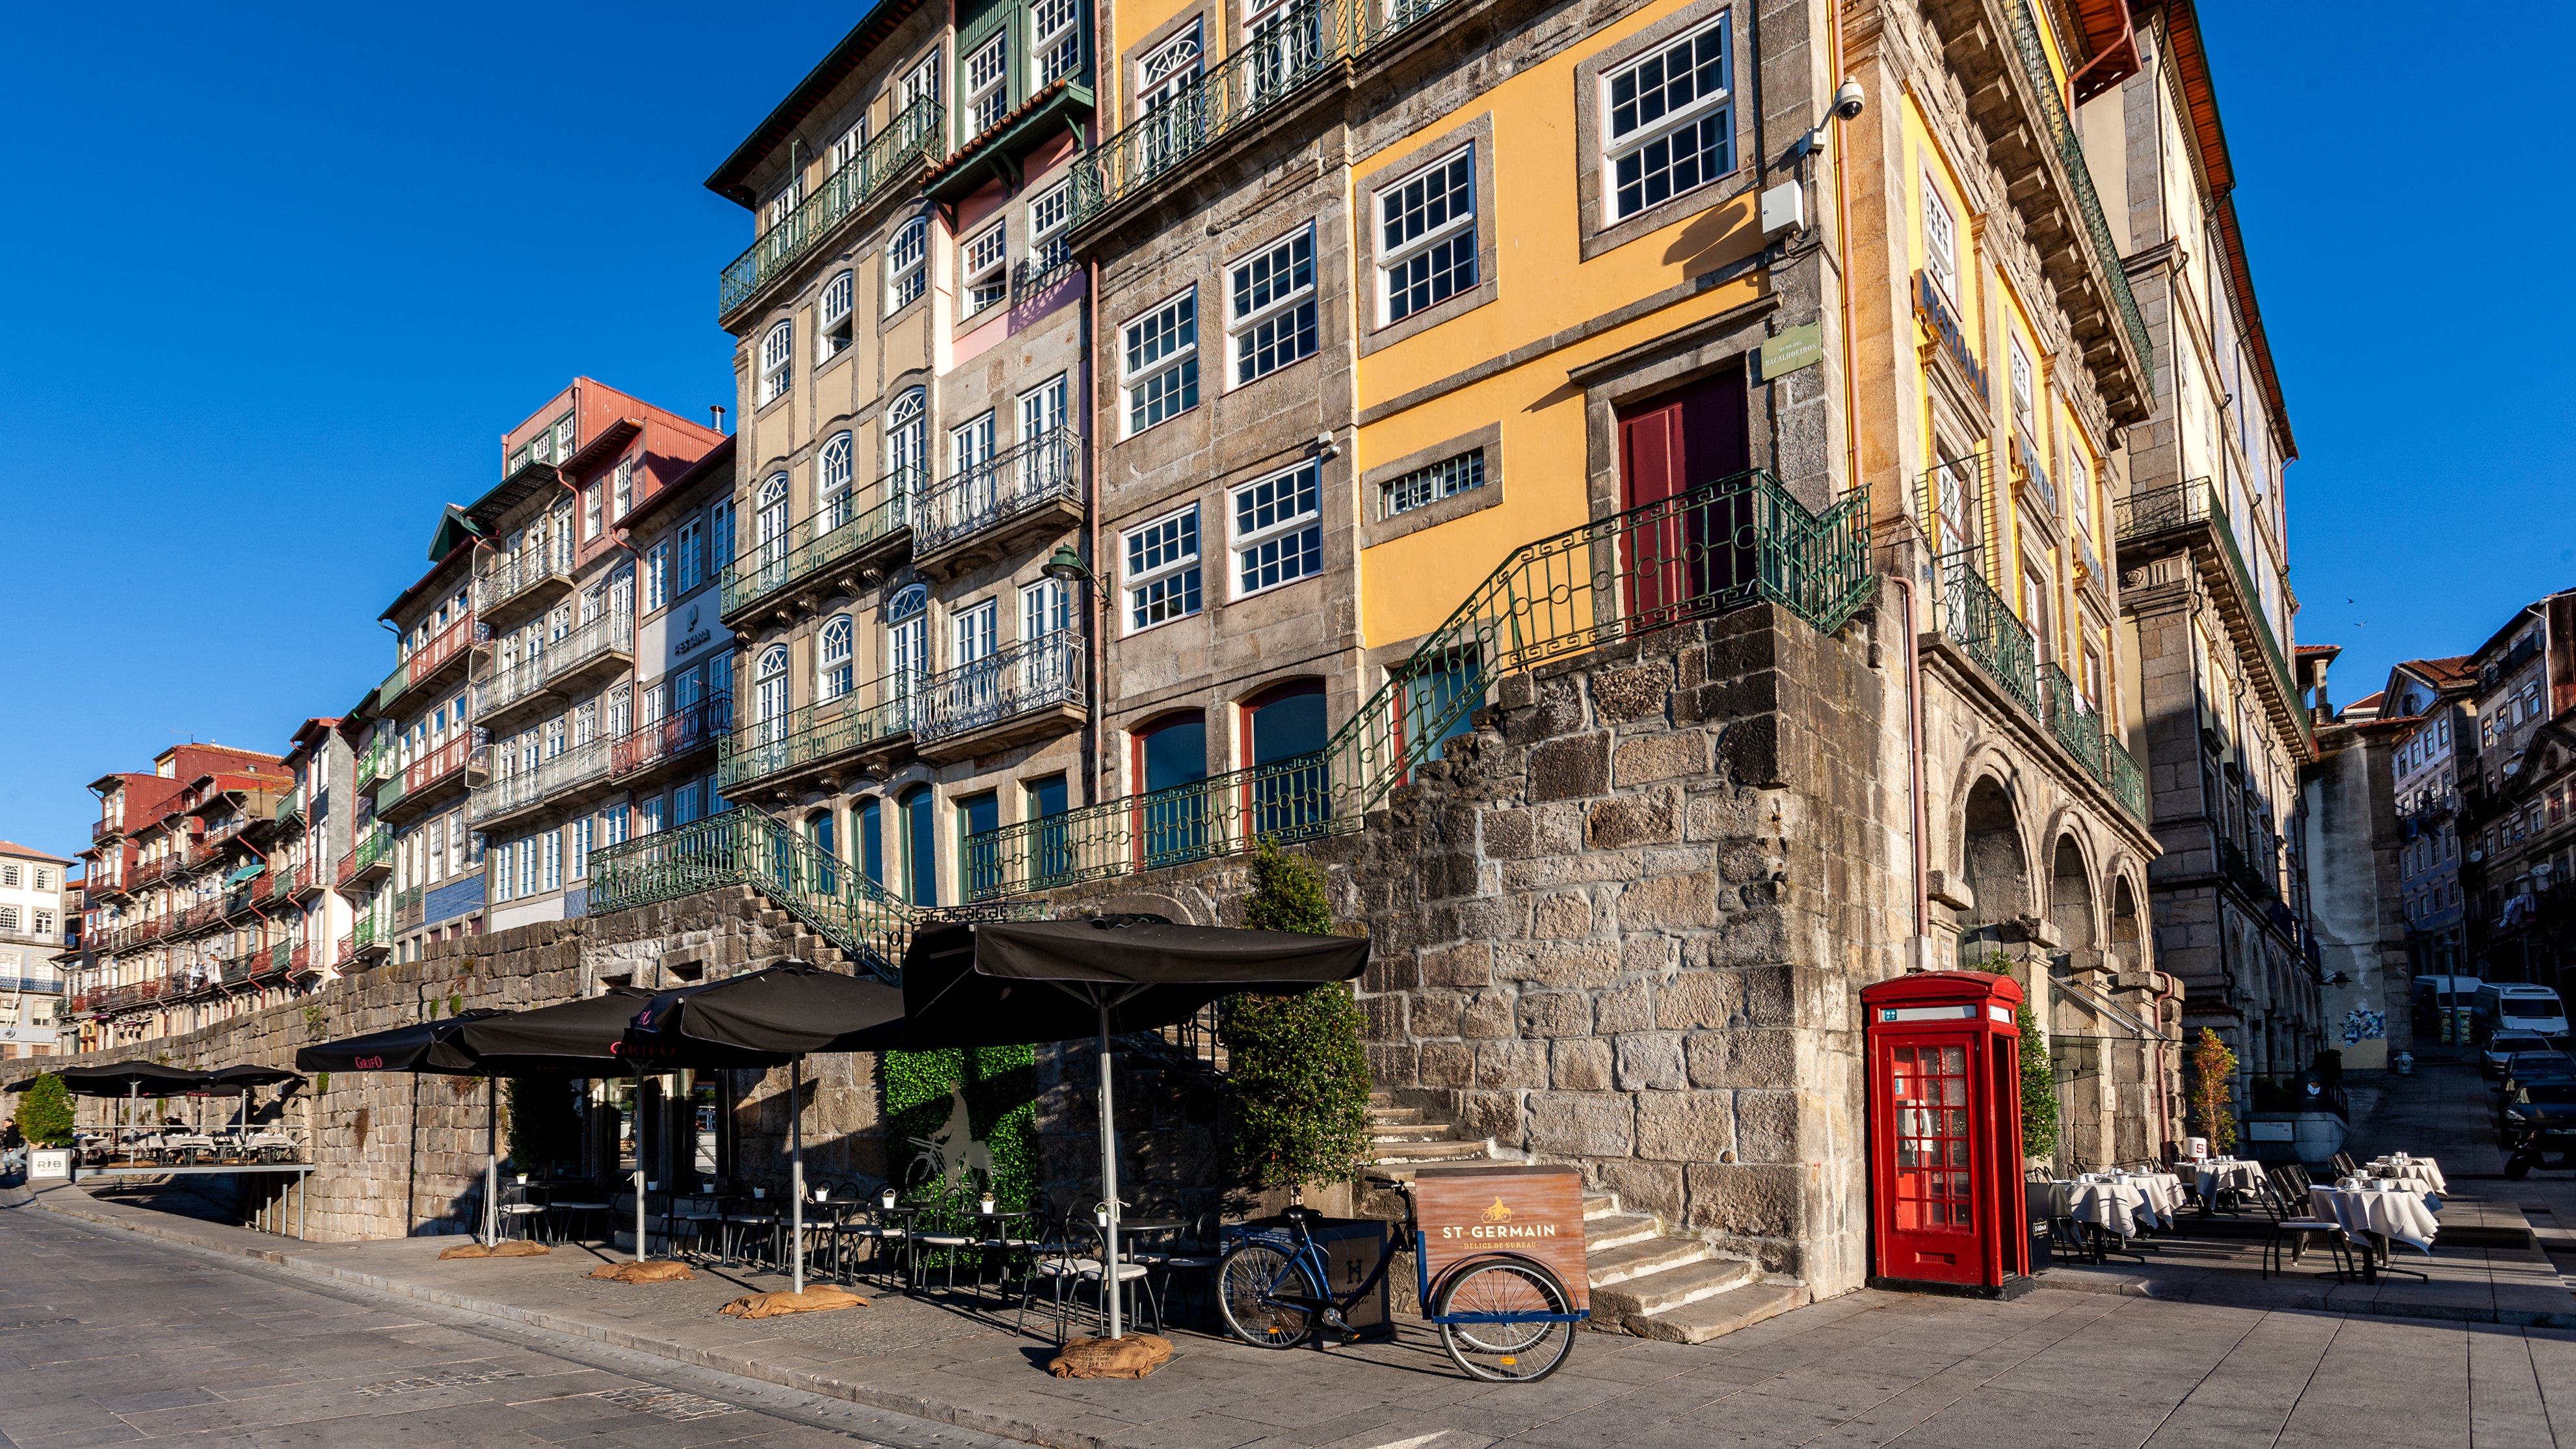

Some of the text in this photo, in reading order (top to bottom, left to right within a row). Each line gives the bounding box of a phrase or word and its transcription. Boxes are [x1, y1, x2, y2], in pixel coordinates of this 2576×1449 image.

[1917, 268, 1990, 413] PESTANA
[1765, 343, 1817, 367] BACALHOEIROS
[675, 629, 710, 654] PESTANA
[354, 1056, 382, 1069] GRIFO
